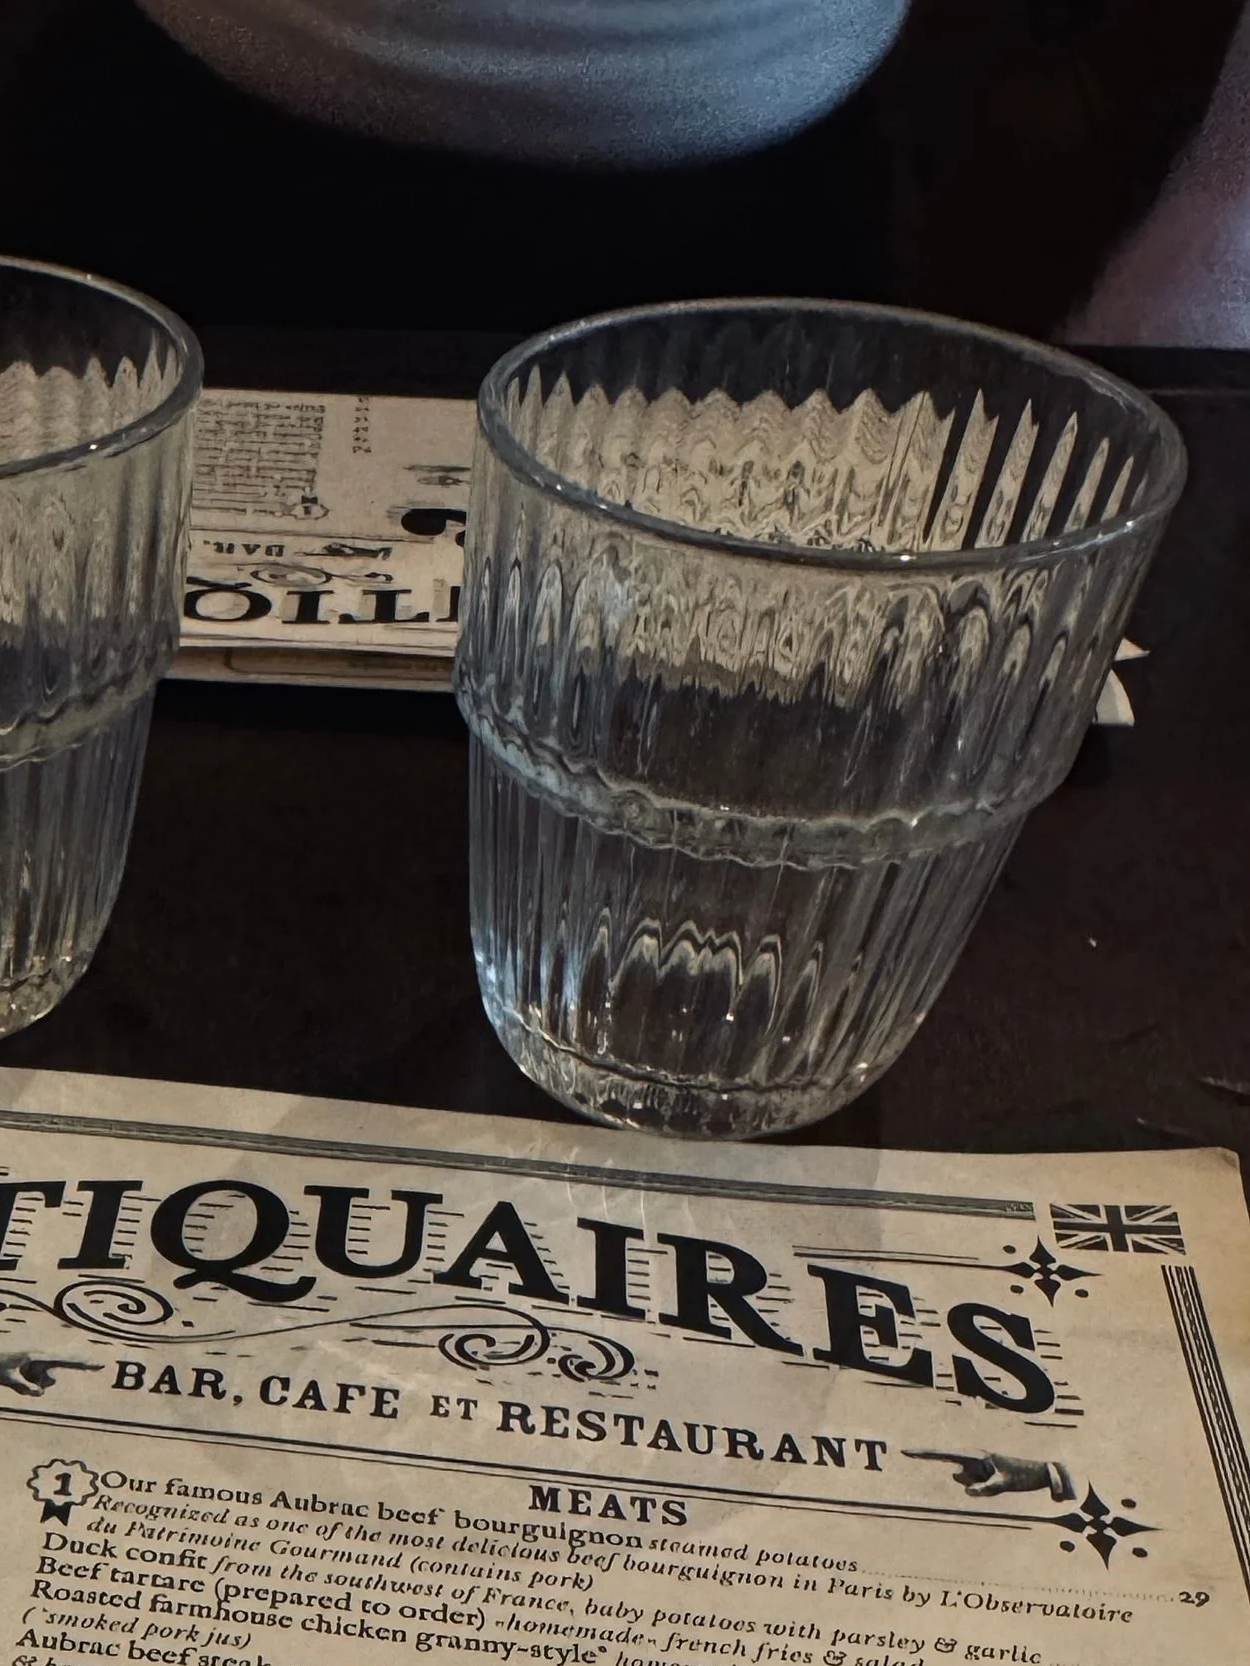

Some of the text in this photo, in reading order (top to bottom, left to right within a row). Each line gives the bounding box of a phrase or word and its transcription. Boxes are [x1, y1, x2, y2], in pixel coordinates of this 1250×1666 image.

[111, 1361, 887, 1472] BAR, CAFE ET RESTAURANT
[528, 1485, 687, 1526] MEATS
[43, 1532, 117, 1558] Duck
[126, 1547, 208, 1569] confit
[213, 1556, 272, 1578] from
[281, 1564, 318, 1582] the
[324, 1574, 443, 1597] southwest
[451, 1586, 480, 1604] of
[482, 1587, 574, 1614] France,
[585, 1598, 643, 1623] baby
[652, 1609, 756, 1632] potatoes
[764, 1623, 820, 1639] with
[831, 1629, 925, 1654] parsley
[934, 1637, 957, 1653] &
[965, 1645, 1041, 1664] garlic
[16, 1629, 120, 1656] Aubrac
[128, 1640, 197, 1666] beef
